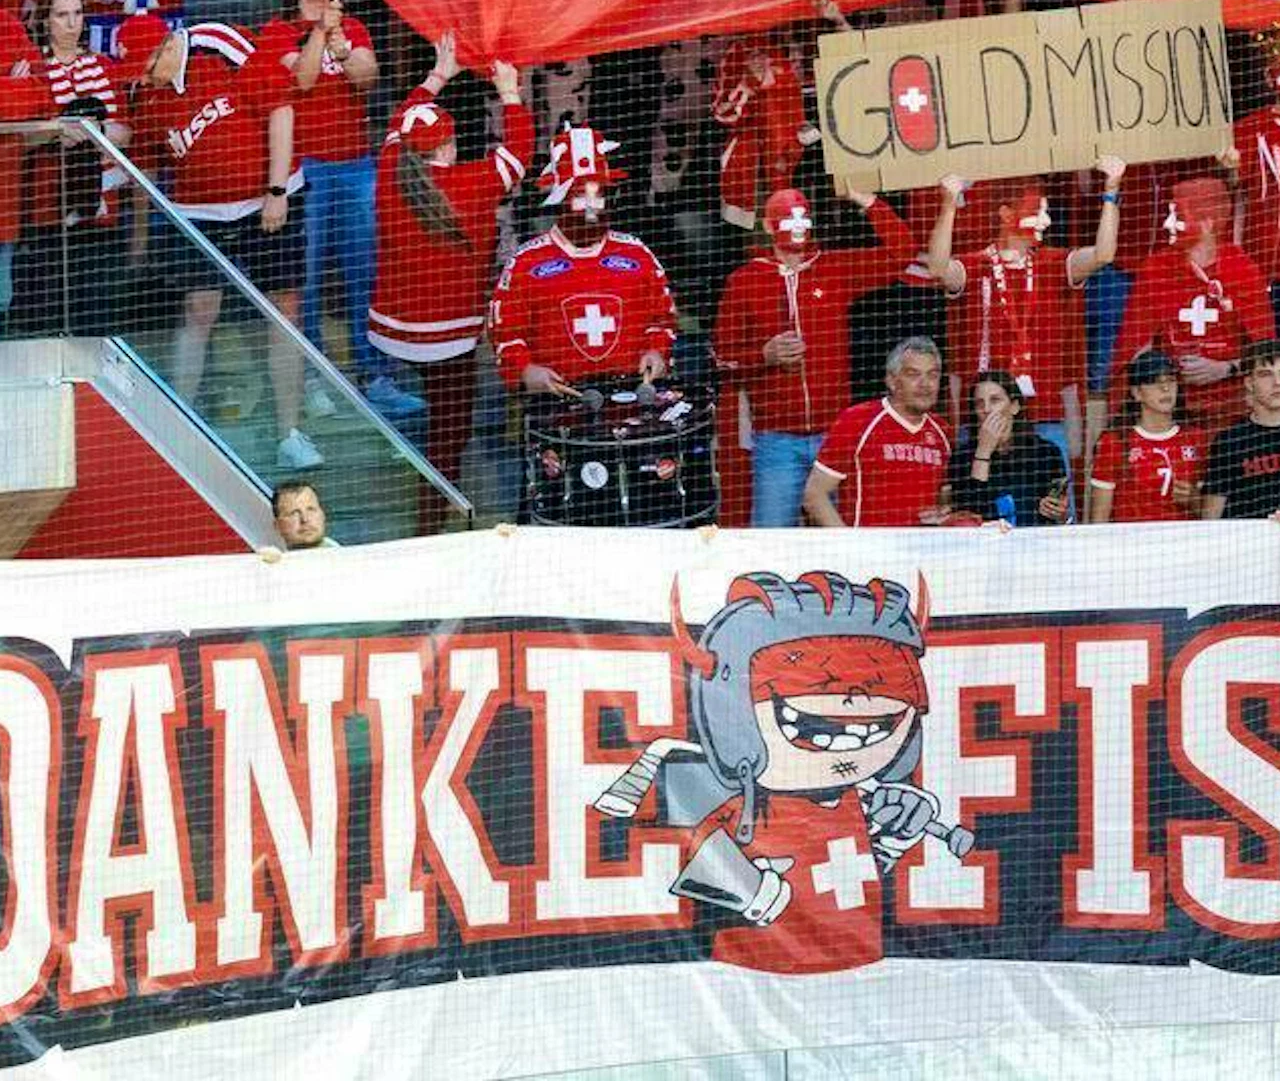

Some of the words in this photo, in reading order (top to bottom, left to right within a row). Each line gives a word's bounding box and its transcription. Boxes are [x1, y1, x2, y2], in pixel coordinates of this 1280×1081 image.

[825, 45, 1032, 159] GOLD
[1043, 23, 1232, 137] MISSION
[1157, 467, 1173, 496] 7
